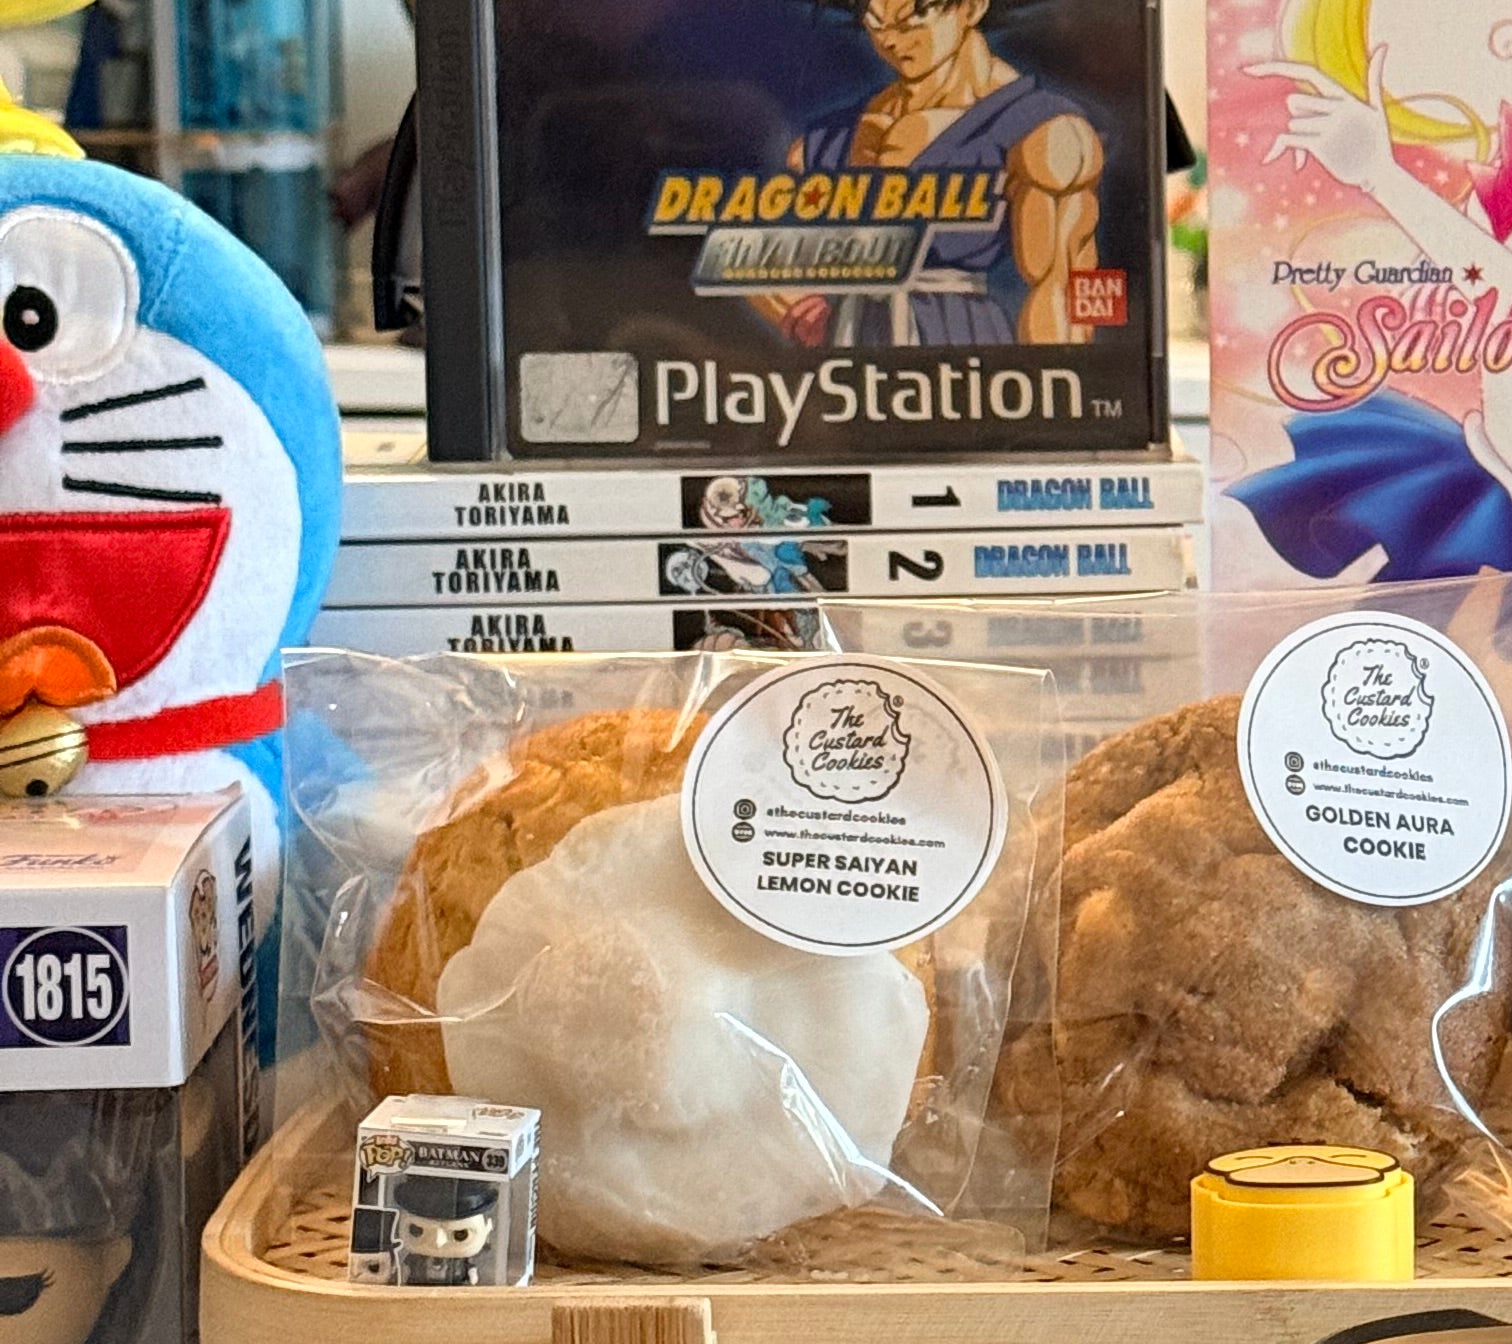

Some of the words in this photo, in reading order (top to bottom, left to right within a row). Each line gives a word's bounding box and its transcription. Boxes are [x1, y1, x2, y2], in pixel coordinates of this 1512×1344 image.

[653, 173, 872, 223] DRAGON
[872, 171, 990, 221] BALL
[1271, 260, 1347, 292] Pretty
[1353, 259, 1454, 287] Guardian
[655, 357, 1084, 448] PlayStation
[478, 481, 547, 504] AKIRA
[911, 484, 962, 509] 1
[997, 477, 1092, 512] DRAGON
[1099, 476, 1155, 511] BALL
[453, 504, 571, 528] TORIYAMA
[455, 547, 533, 572] AKIRA
[888, 549, 945, 582] 2
[974, 543, 1071, 578] DRAGON
[1077, 542, 1132, 576] BALL
[432, 569, 561, 595] TORIYAMA
[470, 613, 547, 638] AKIRA
[1362, 665, 1393, 687] The
[1343, 685, 1416, 707] Custard
[831, 706, 865, 729] The
[1347, 707, 1411, 728] Cookies
[808, 724, 889, 751] Custard
[811, 751, 884, 772] Cookies
[1305, 805, 1391, 830] GOLDEN
[1396, 814, 1455, 836] AURA
[1343, 836, 1426, 860] COOKIE
[762, 851, 830, 870] SUPER
[834, 855, 918, 876] SAIYAN
[757, 875, 832, 895] LEMON
[837, 880, 920, 902] COOKIE
[15, 953, 113, 1021] 1815
[418, 1146, 480, 1163] BATMAN
